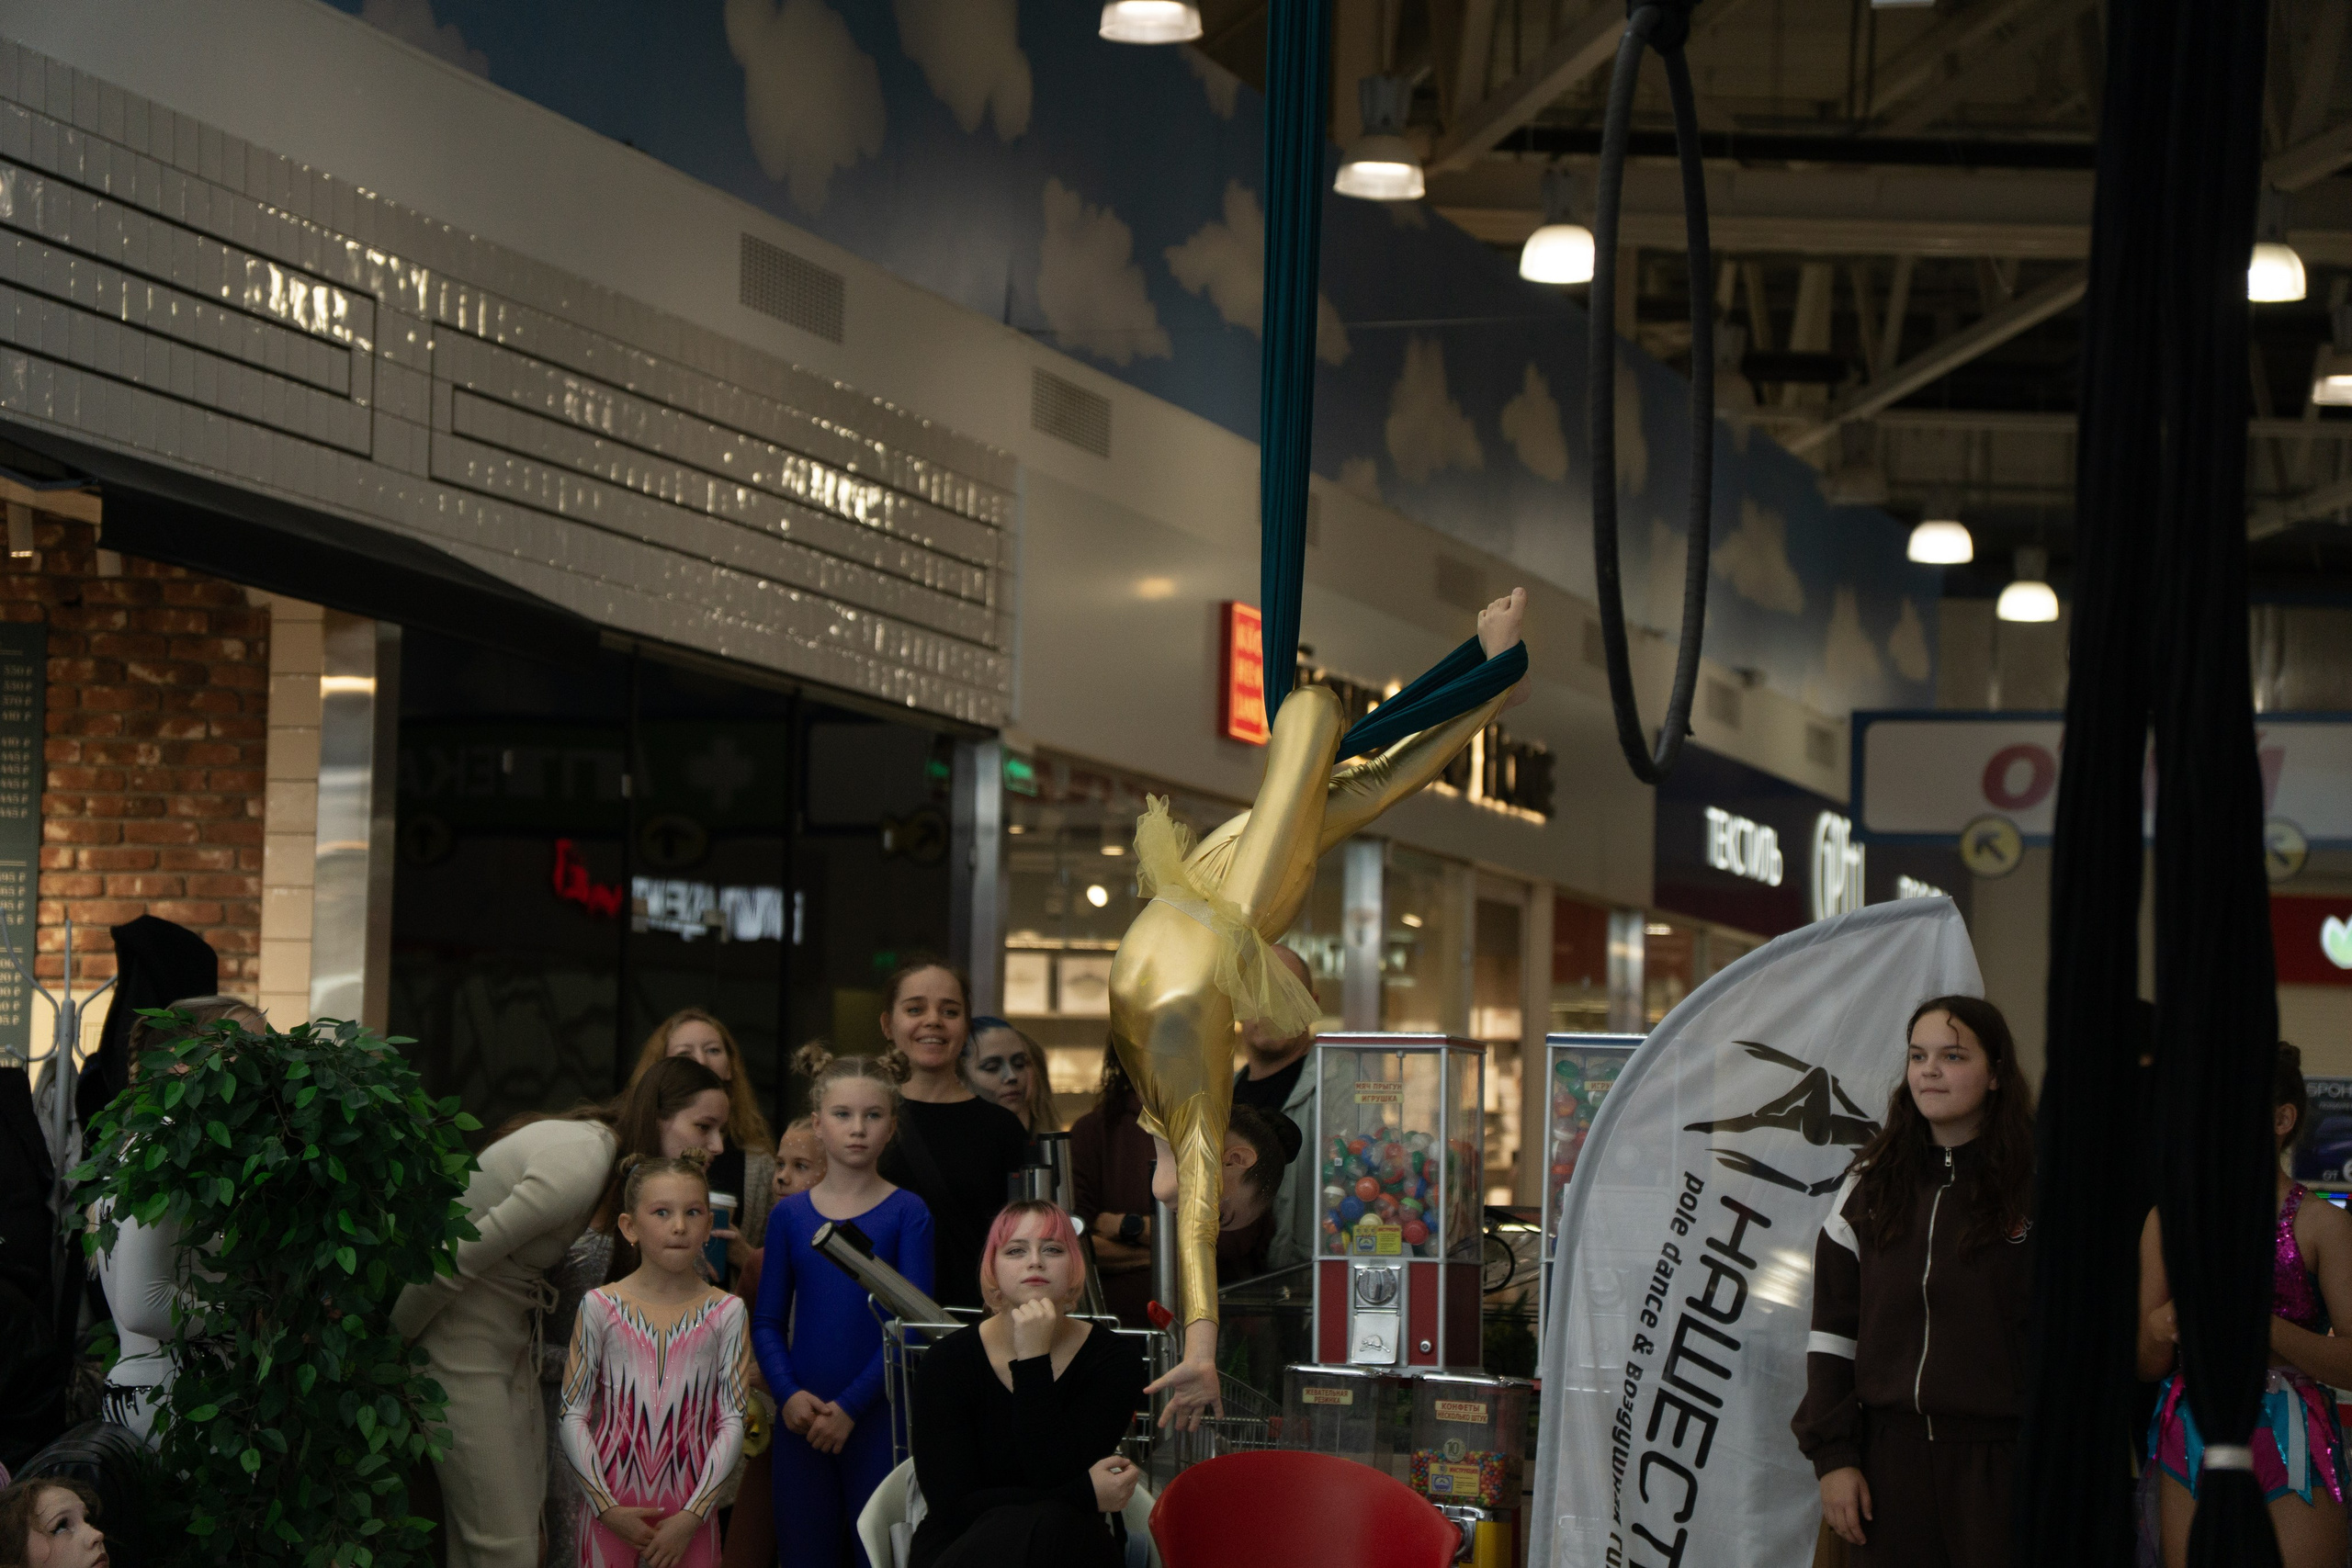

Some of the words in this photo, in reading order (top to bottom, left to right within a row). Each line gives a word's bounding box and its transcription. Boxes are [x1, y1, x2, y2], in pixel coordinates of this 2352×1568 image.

[1705, 806, 1783, 887] ТЕКСТИЛЬ
[1670, 1171, 1704, 1236] pole
[1640, 1242, 1682, 1328] dance
[1632, 1333, 1655, 1356] &
[1305, 1389, 1349, 1397] ЖЕВАТЕЛЬНАЯ
[1628, 1195, 1772, 1568] НАШЕСТ
[1437, 1411, 1470, 1421] НЕСКОЛЬКО
[1471, 1414, 1487, 1423] ШТУК
[1441, 1402, 1480, 1412] КОНФЕТЫ
[1446, 1441, 1460, 1455] 10
[1606, 1532, 1623, 1568] ги
